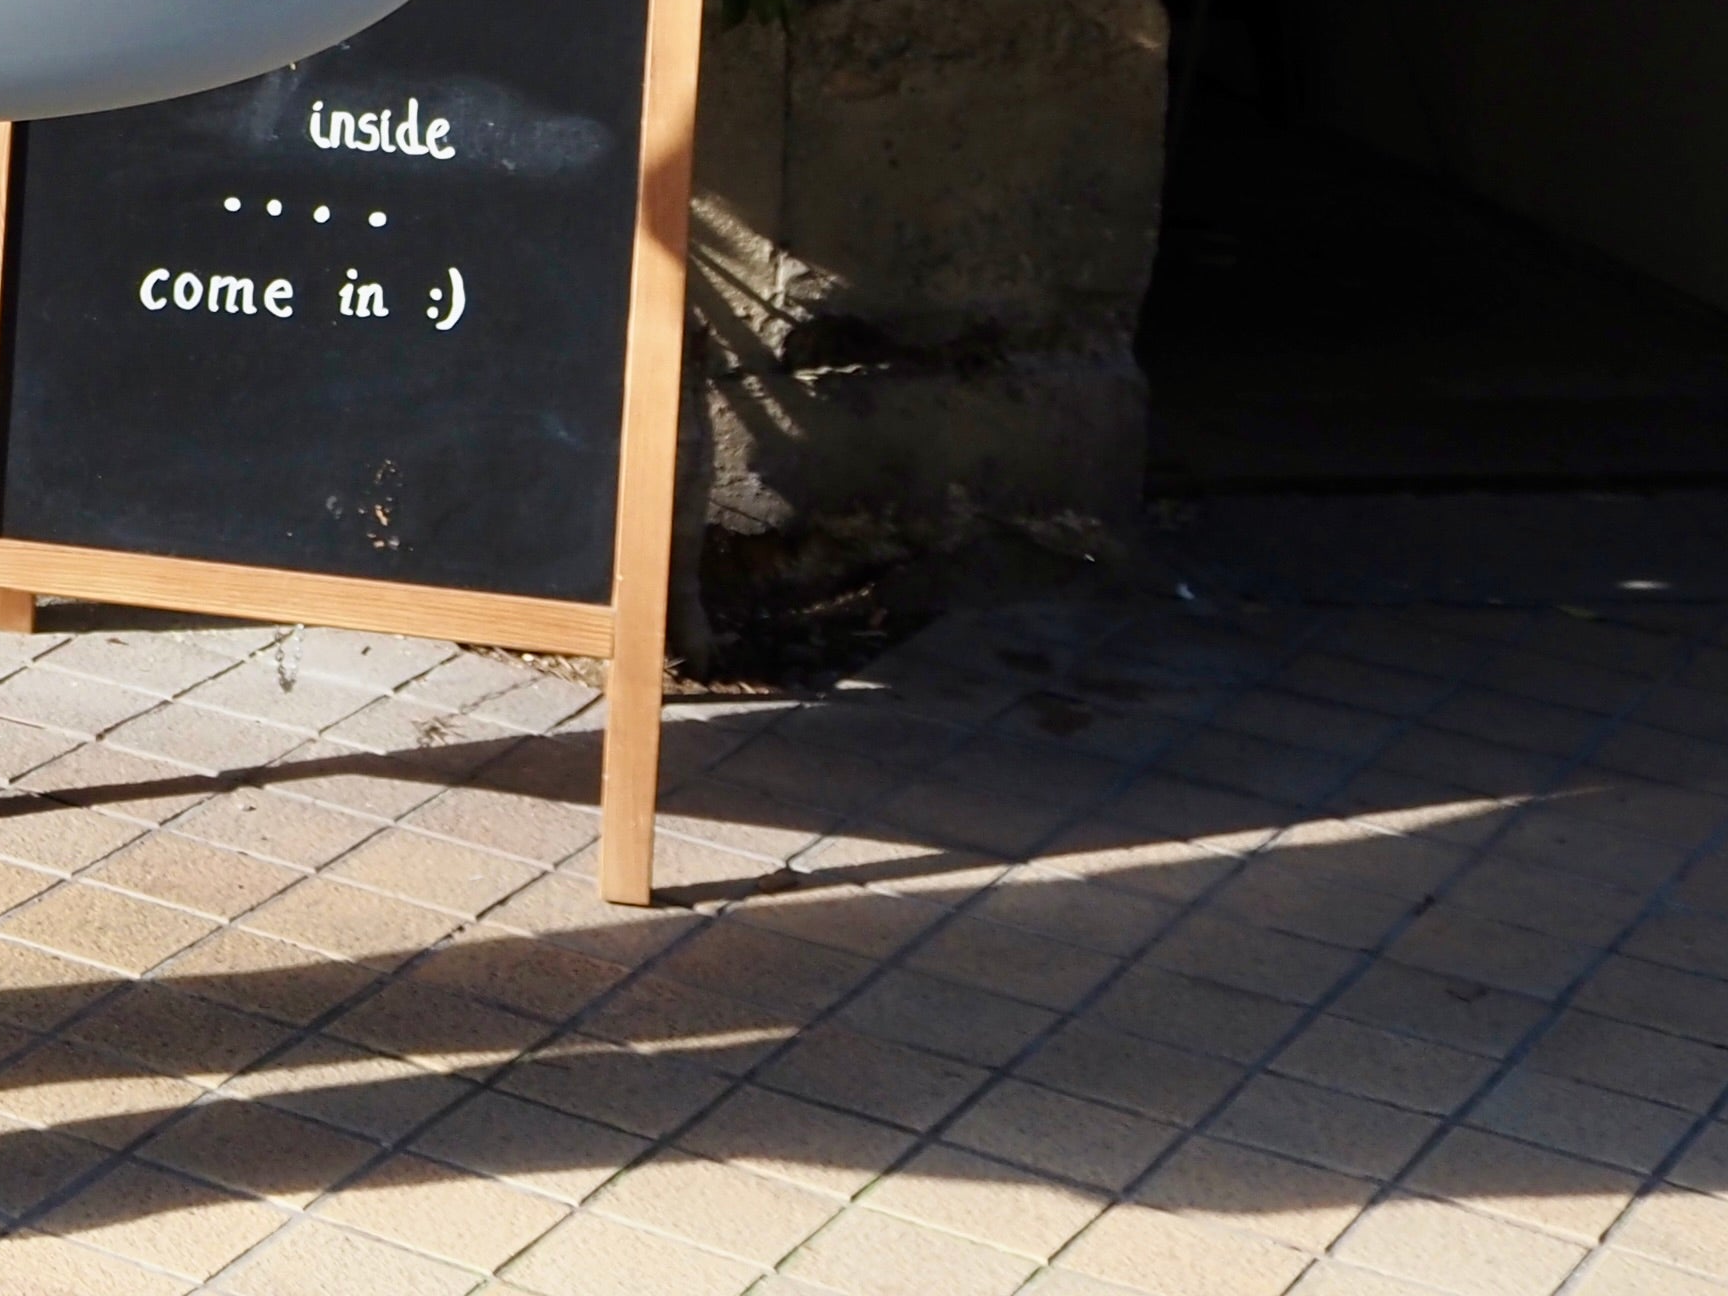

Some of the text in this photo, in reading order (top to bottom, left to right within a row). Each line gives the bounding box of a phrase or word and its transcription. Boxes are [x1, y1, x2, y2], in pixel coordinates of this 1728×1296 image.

[309, 97, 456, 160] inside
[140, 267, 294, 319] come
[338, 268, 389, 319] in
